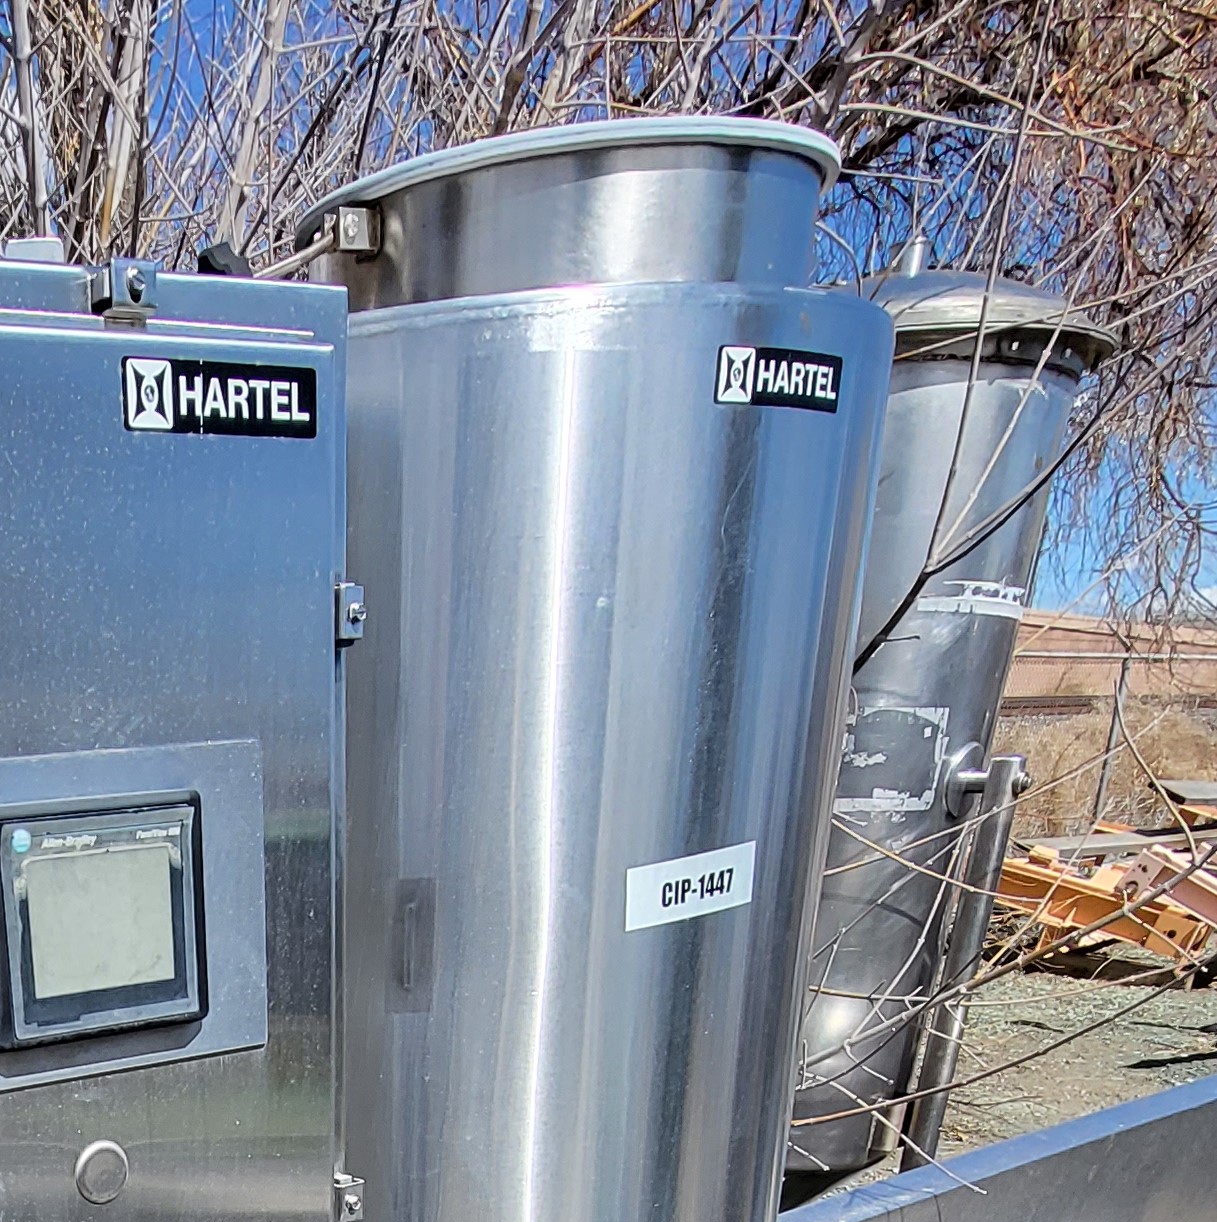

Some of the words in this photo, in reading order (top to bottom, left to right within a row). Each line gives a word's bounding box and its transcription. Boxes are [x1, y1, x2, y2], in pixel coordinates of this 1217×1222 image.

[179, 375, 310, 422] HARTEL
[756, 359, 836, 400] HARTEL
[661, 868, 733, 908] CIP-1447
